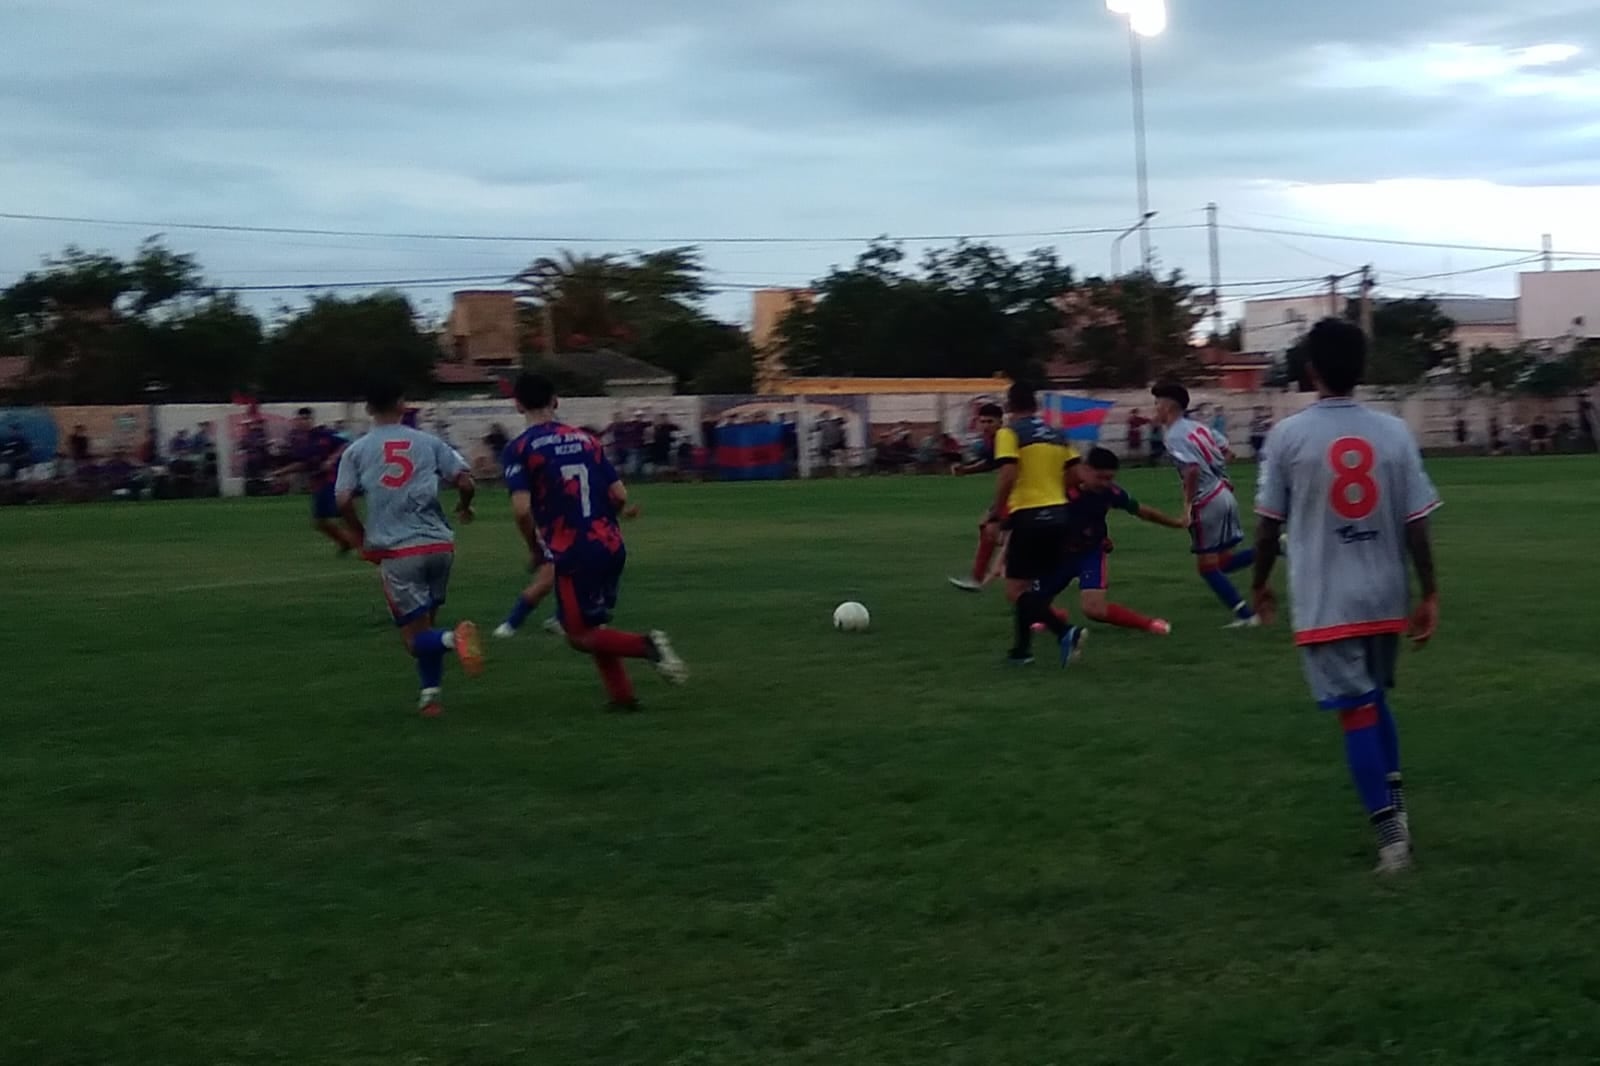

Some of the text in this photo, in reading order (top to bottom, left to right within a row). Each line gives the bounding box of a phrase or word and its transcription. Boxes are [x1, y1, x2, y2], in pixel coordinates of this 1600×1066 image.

[380, 440, 414, 488] 5
[560, 464, 590, 518] 7
[1328, 437, 1378, 520] 8
